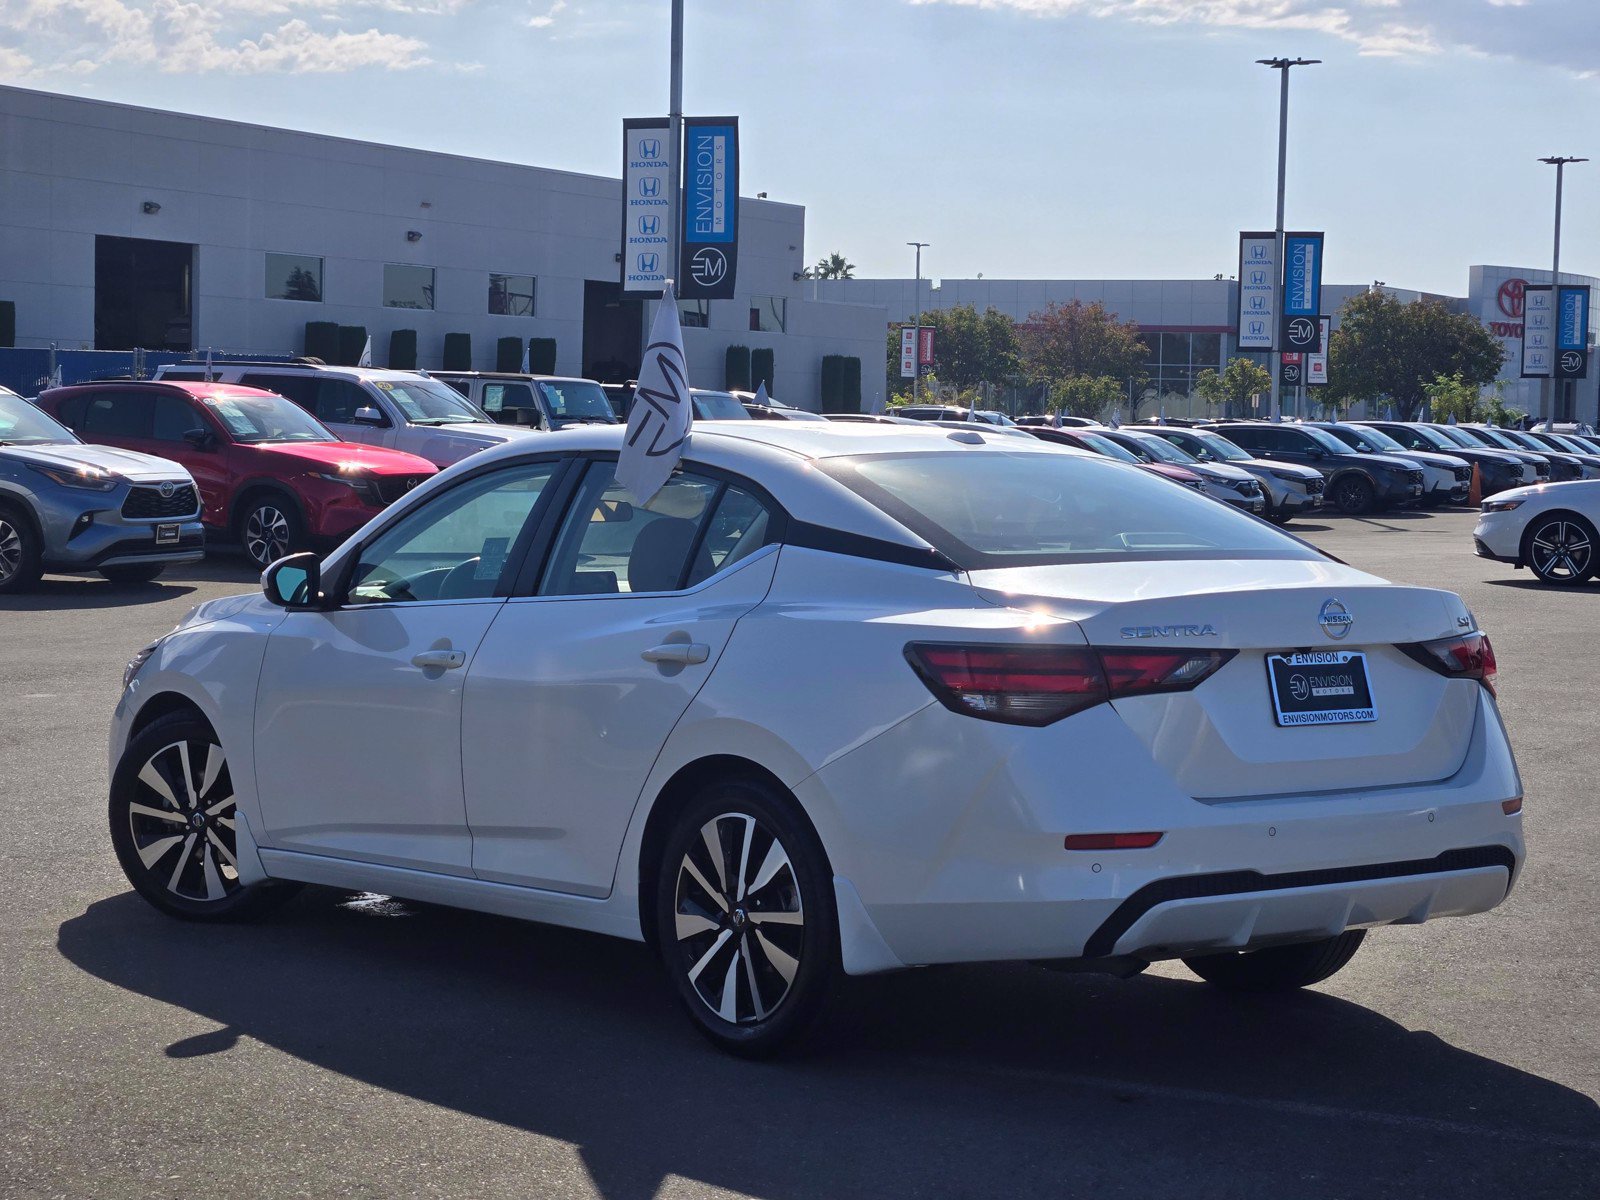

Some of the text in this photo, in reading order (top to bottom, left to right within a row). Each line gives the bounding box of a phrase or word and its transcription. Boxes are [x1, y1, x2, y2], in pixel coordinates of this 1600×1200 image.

[696, 136, 713, 233] ENVISION
[1292, 244, 1305, 310] ENVISION
[1488, 322, 1524, 338] TOYO
[1324, 615, 1352, 623] NISSAN
[1120, 624, 1217, 639] SENTRA
[1296, 653, 1339, 664] ENVISION
[1310, 675, 1353, 688] ENVISION
[1283, 710, 1375, 724] ENVISIONMOTORS.COM
